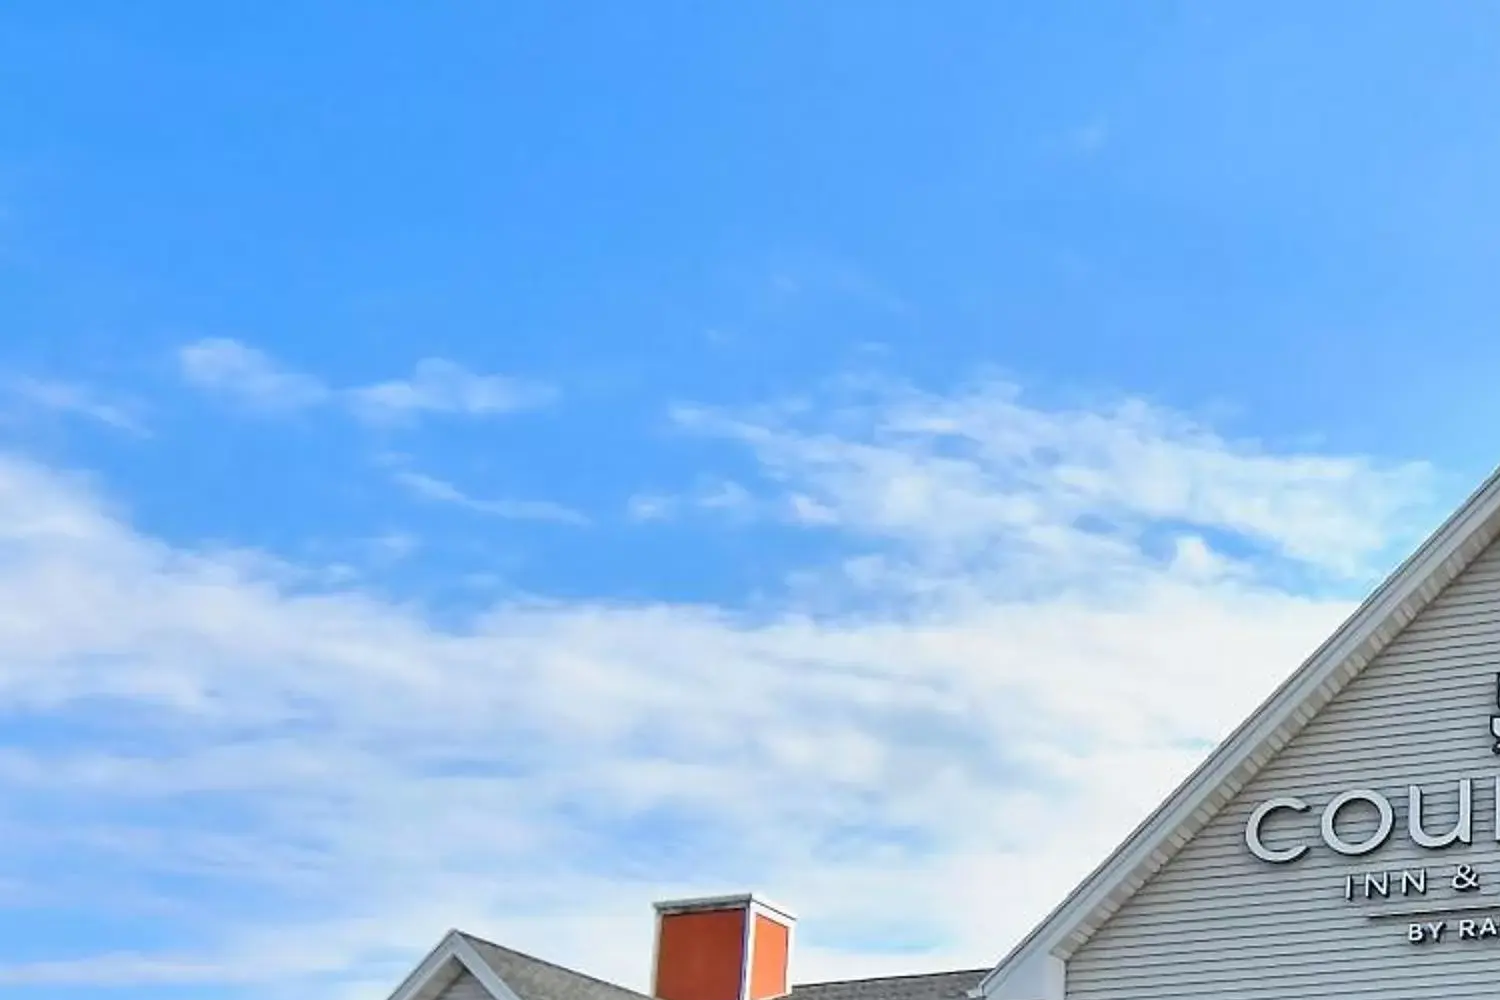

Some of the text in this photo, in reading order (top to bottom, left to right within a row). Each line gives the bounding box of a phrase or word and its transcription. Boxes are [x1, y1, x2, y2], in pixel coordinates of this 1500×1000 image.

[1344, 867, 1428, 901] INN
[1450, 864, 1480, 890] &
[1407, 920, 1448, 943] BY
